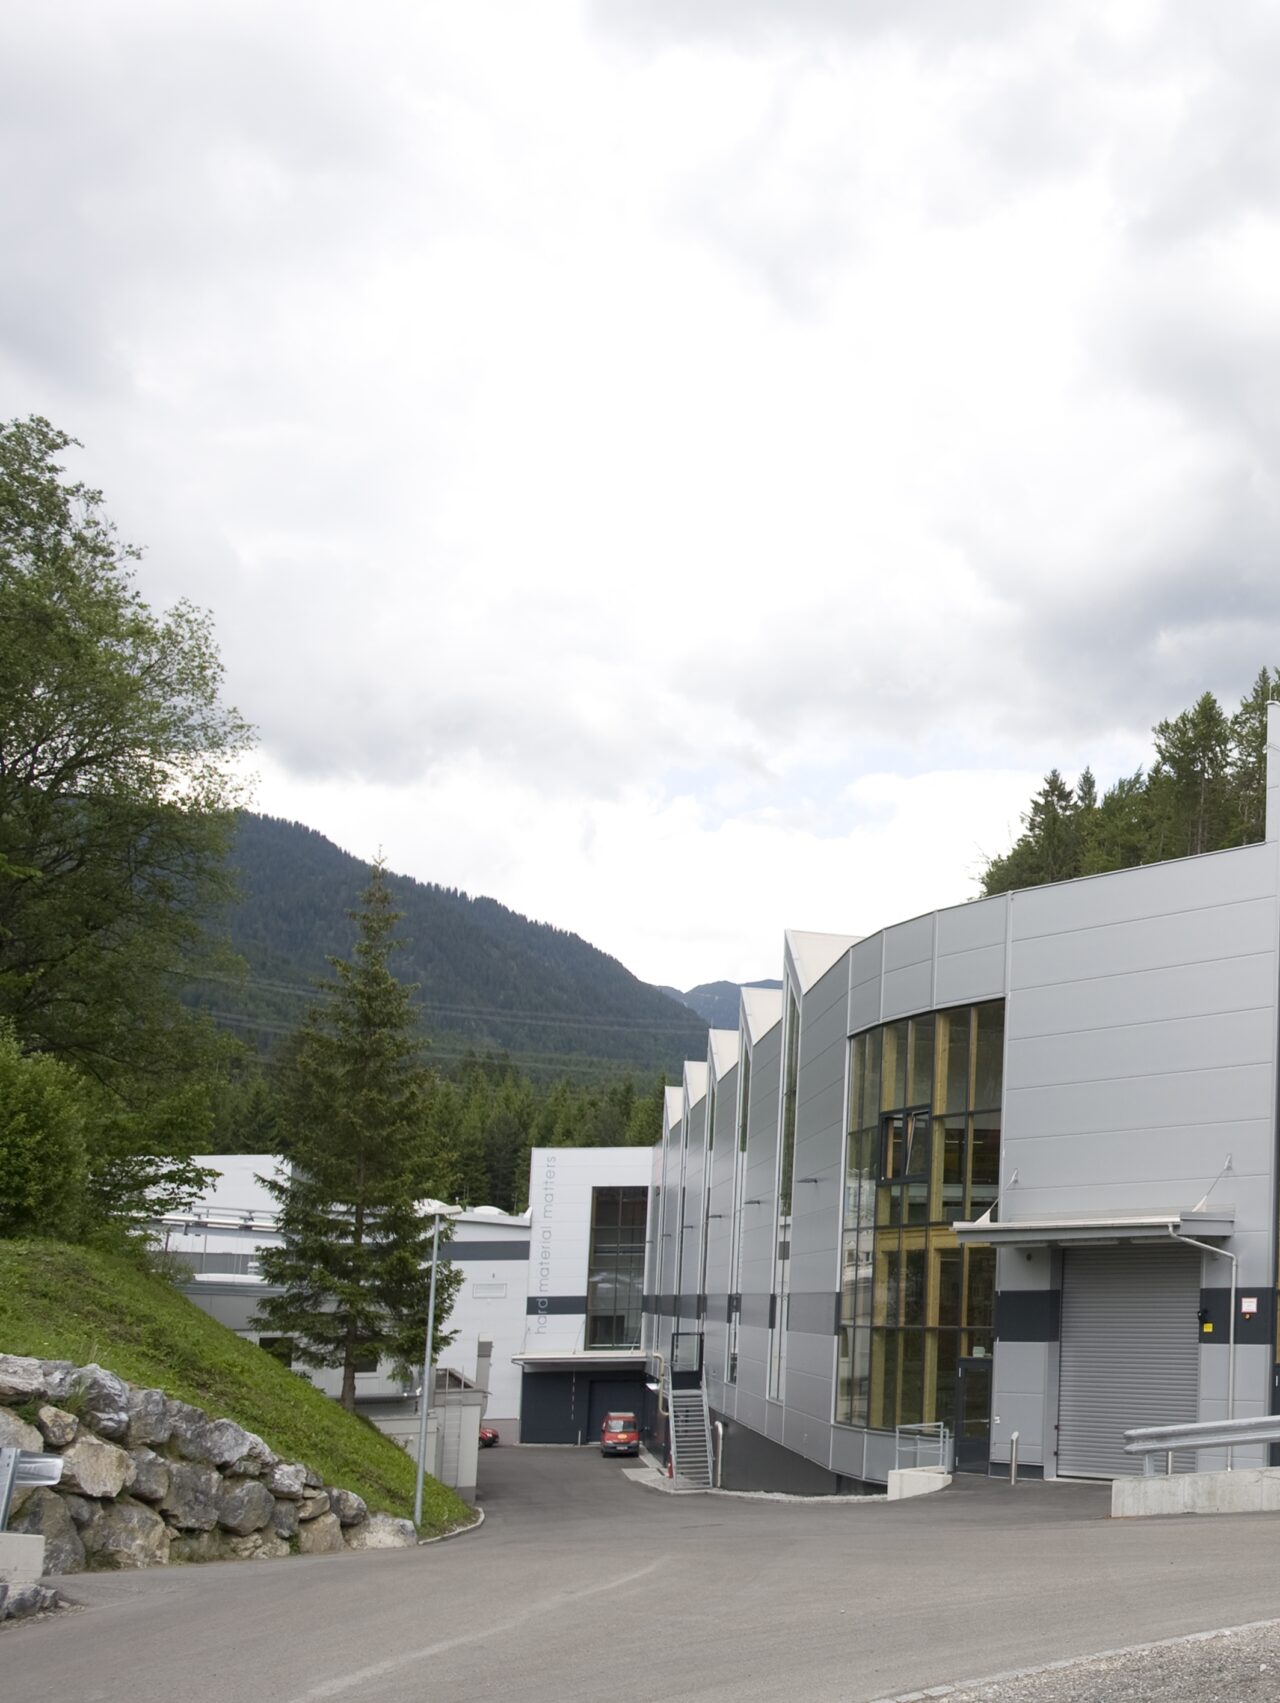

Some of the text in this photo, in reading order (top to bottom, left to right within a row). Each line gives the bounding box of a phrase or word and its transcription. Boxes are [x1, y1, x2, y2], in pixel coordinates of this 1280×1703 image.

[535, 1156, 556, 1335] hard material matters
